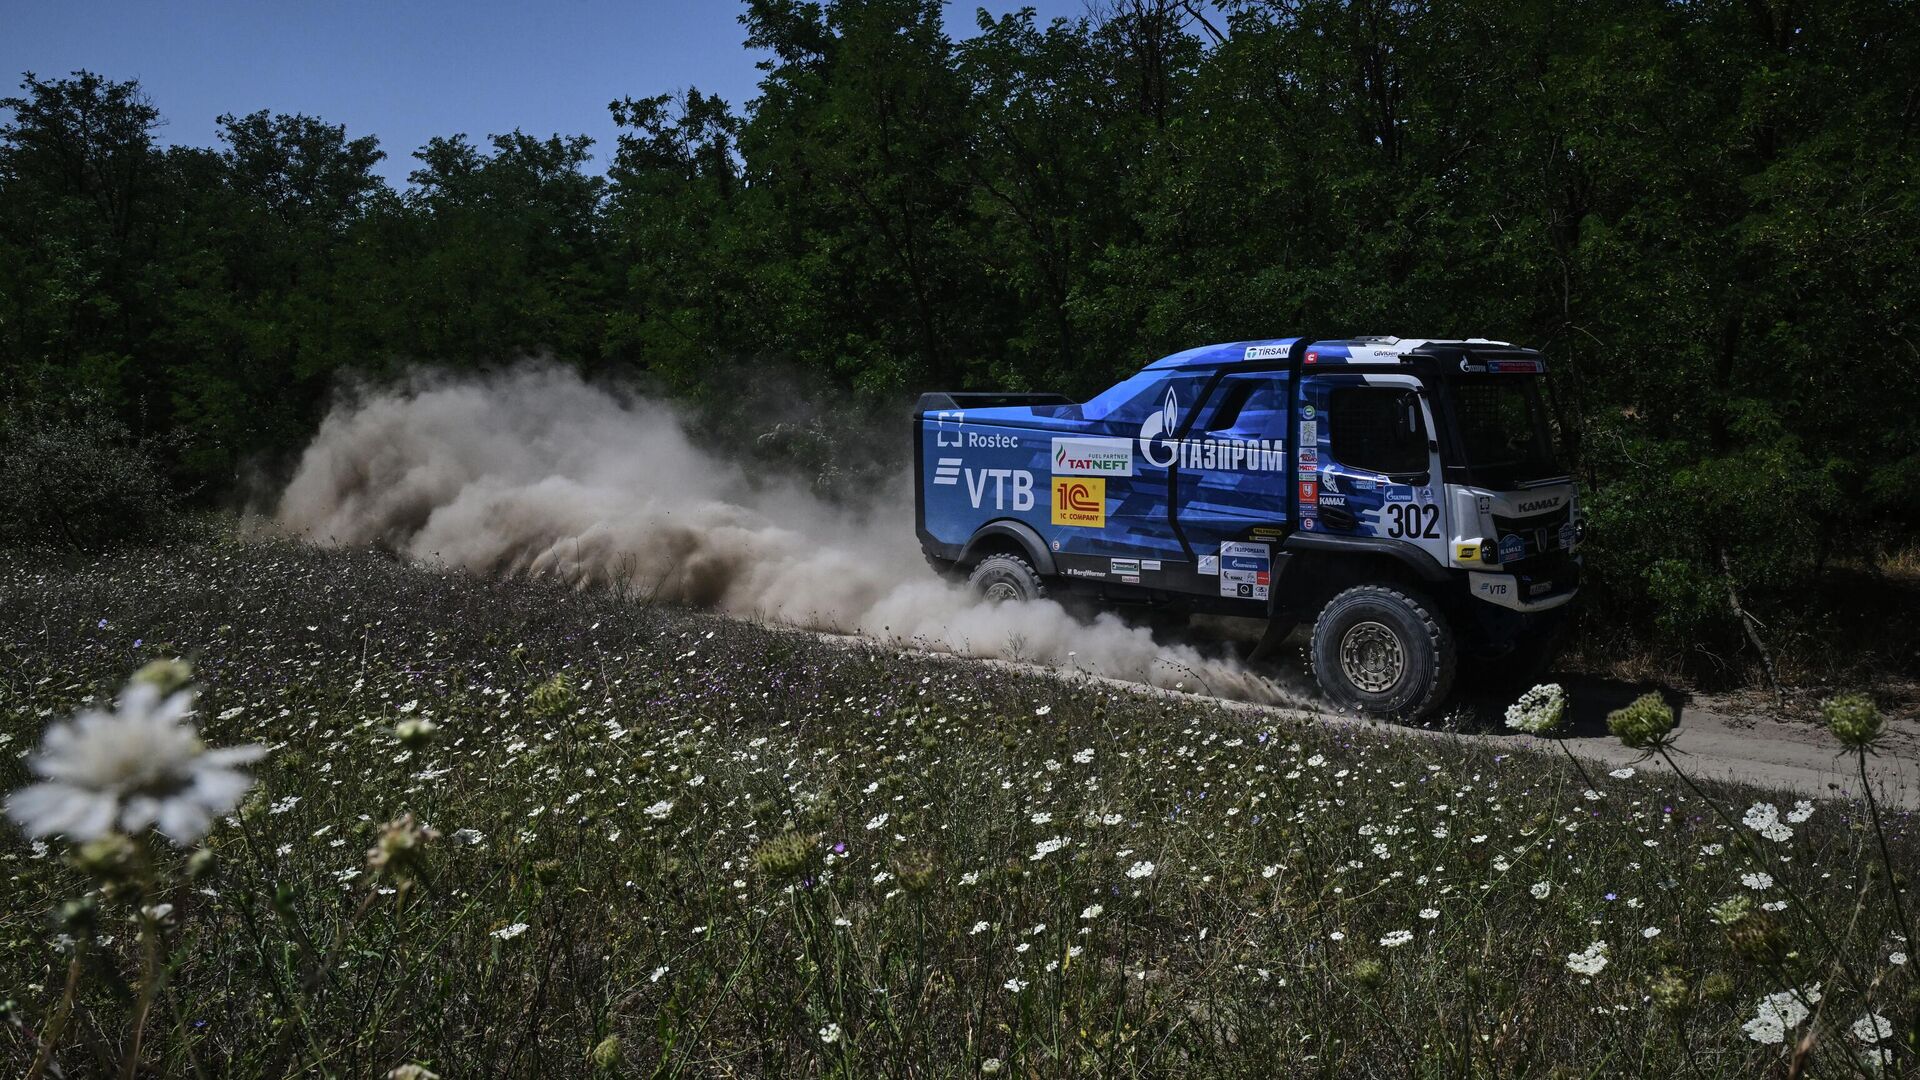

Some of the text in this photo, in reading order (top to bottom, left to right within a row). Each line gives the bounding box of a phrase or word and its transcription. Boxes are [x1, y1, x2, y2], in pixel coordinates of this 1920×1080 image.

[968, 432, 1019, 448] Rostec
[1180, 438, 1283, 471] ГАЗПРОМ
[1068, 459, 1128, 470] TATNEFT
[964, 468, 1035, 511] VTB
[1319, 497, 1345, 506] KAMAZ
[1518, 497, 1560, 513] KAMAZ
[1069, 513, 1099, 521] COMPANY
[1387, 503, 1440, 539] 302
[1489, 584, 1507, 594] VTB
